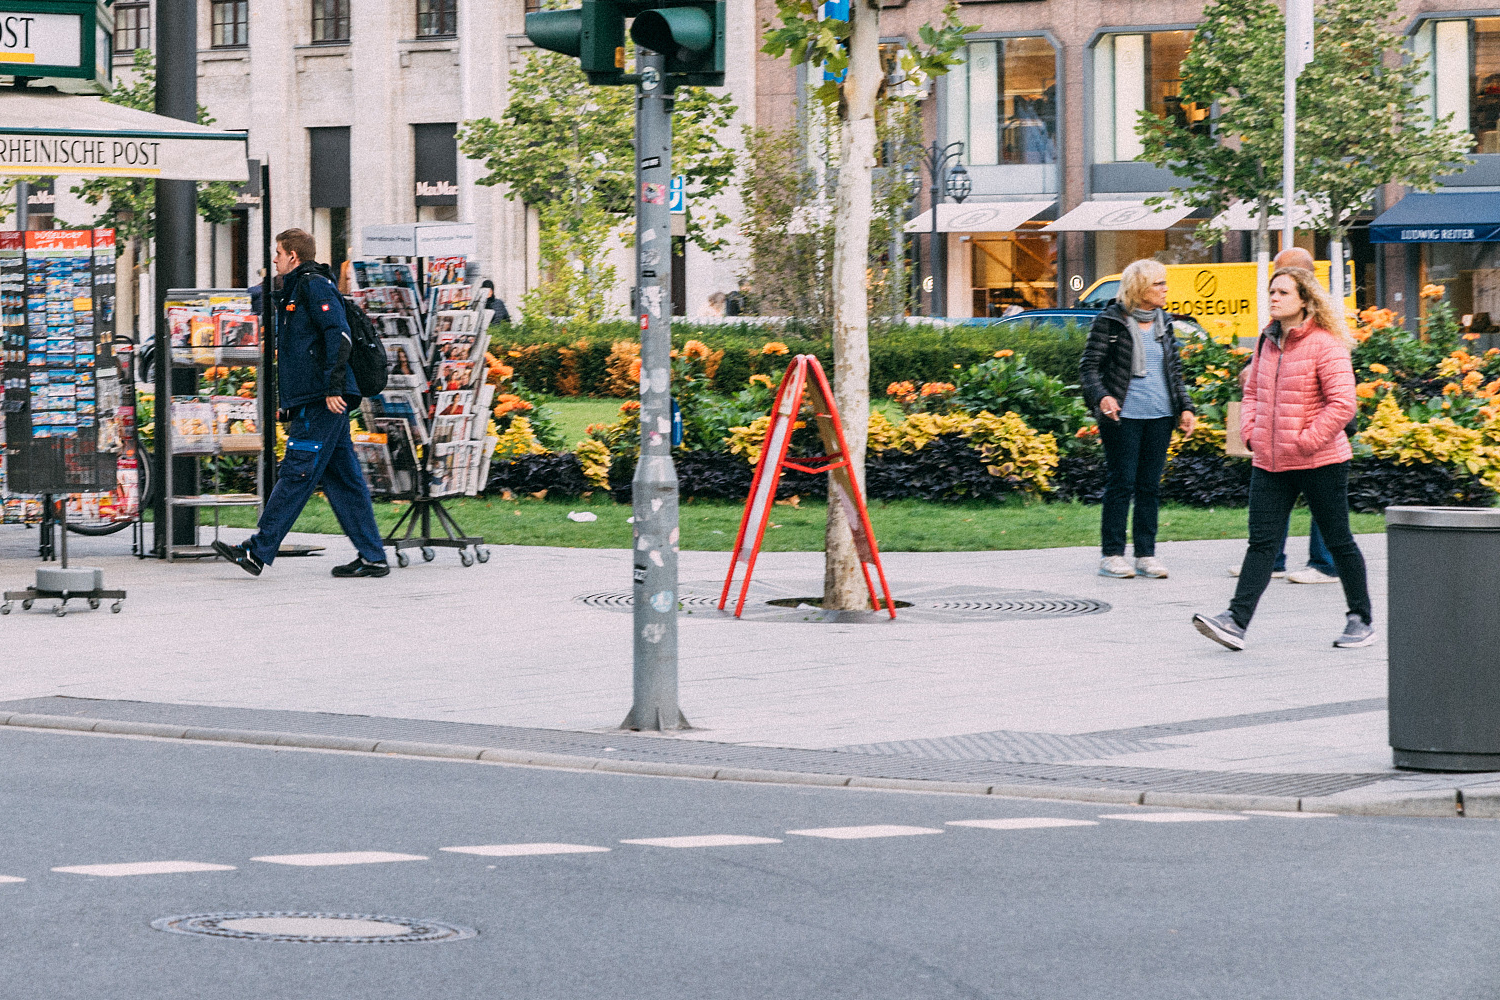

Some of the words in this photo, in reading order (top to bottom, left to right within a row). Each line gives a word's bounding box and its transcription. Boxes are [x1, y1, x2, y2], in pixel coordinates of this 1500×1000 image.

[112, 142, 161, 165] POST
[1401, 229, 1440, 239] LUDWIG
[1441, 229, 1476, 239] REITER
